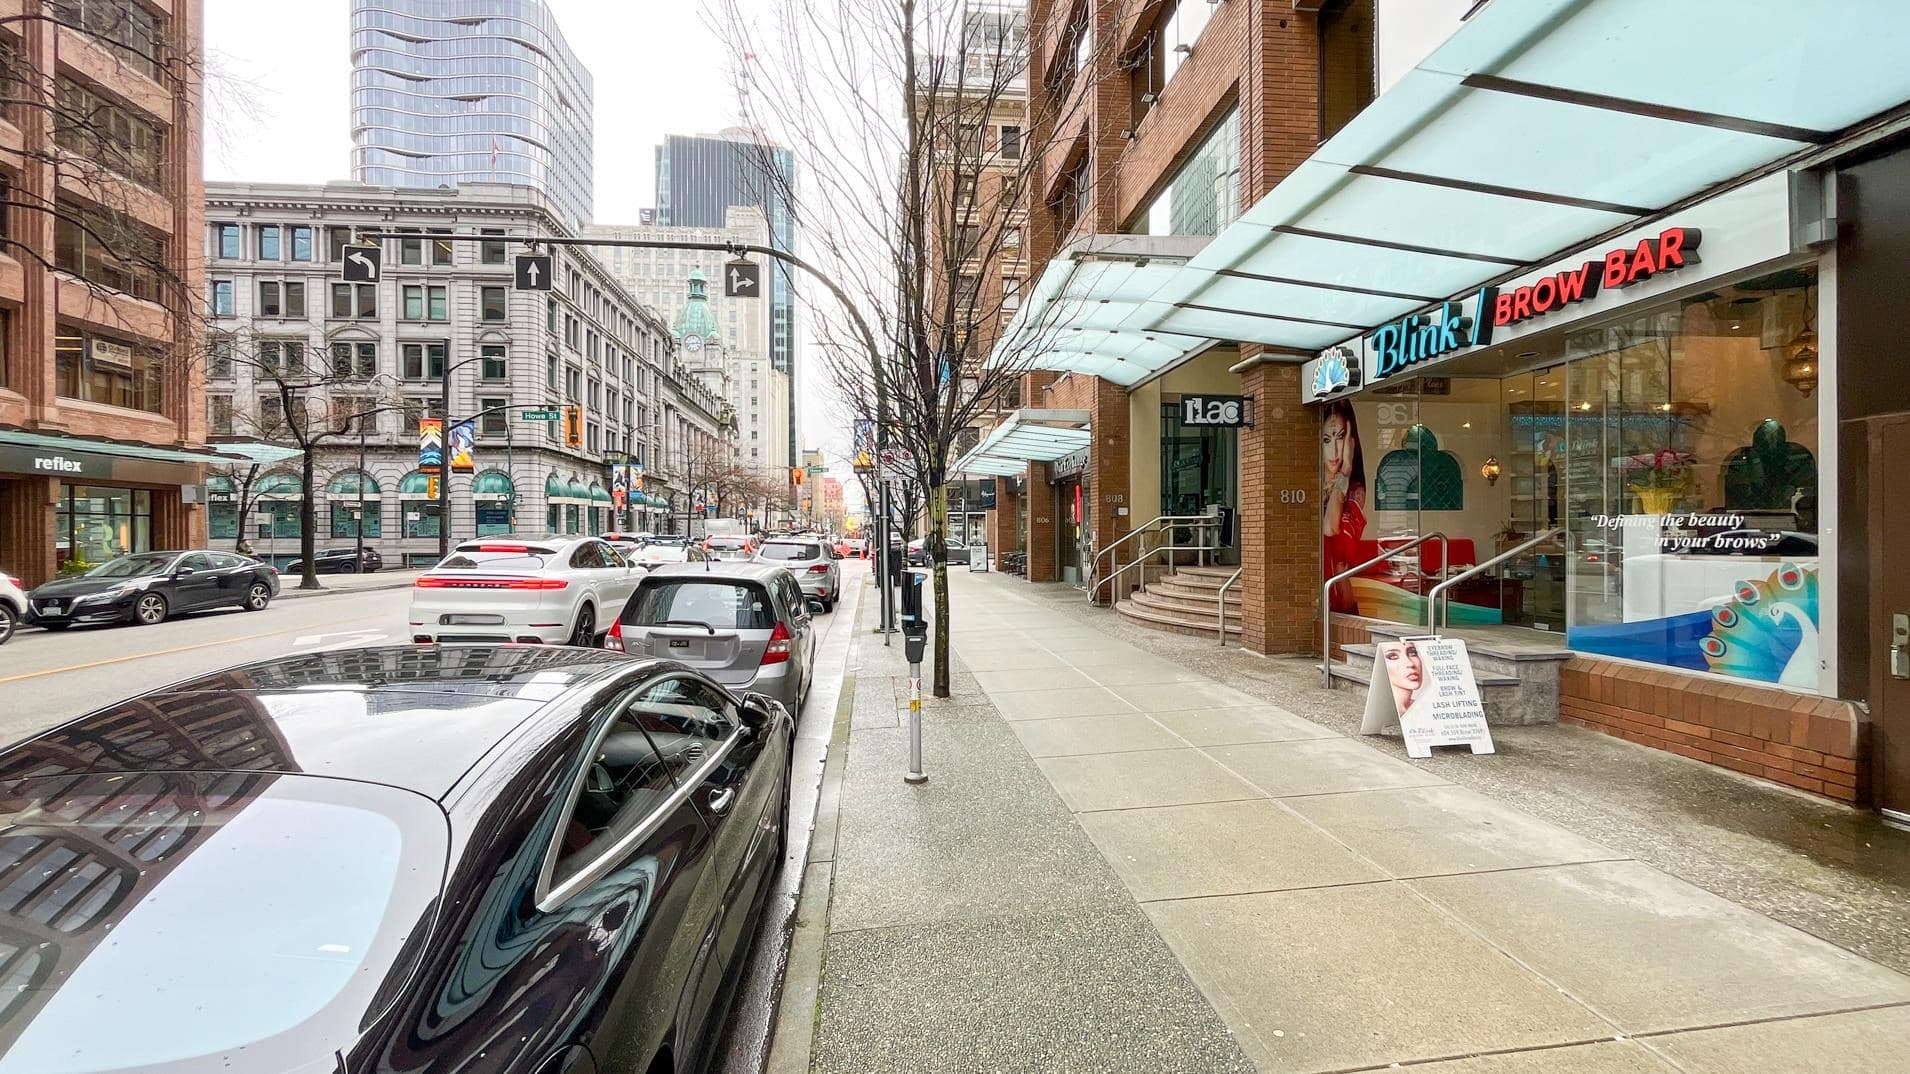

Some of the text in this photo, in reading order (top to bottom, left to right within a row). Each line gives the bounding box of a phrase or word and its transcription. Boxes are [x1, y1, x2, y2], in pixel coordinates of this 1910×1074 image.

[1372, 301, 1461, 378] Blink
[1495, 262, 1590, 327] BROW
[1603, 227, 1686, 289] BAR
[34, 456, 82, 472] reflex
[1105, 494, 1123, 503] 808
[1280, 489, 1306, 503] 810
[1660, 513, 1684, 527] the
[1689, 512, 1744, 530] beauty
[1654, 535, 1668, 547] in
[1671, 536, 1711, 551] your
[1432, 700, 1478, 709] LASH LIFTING
[1432, 711, 1484, 720] MICROBLADING
